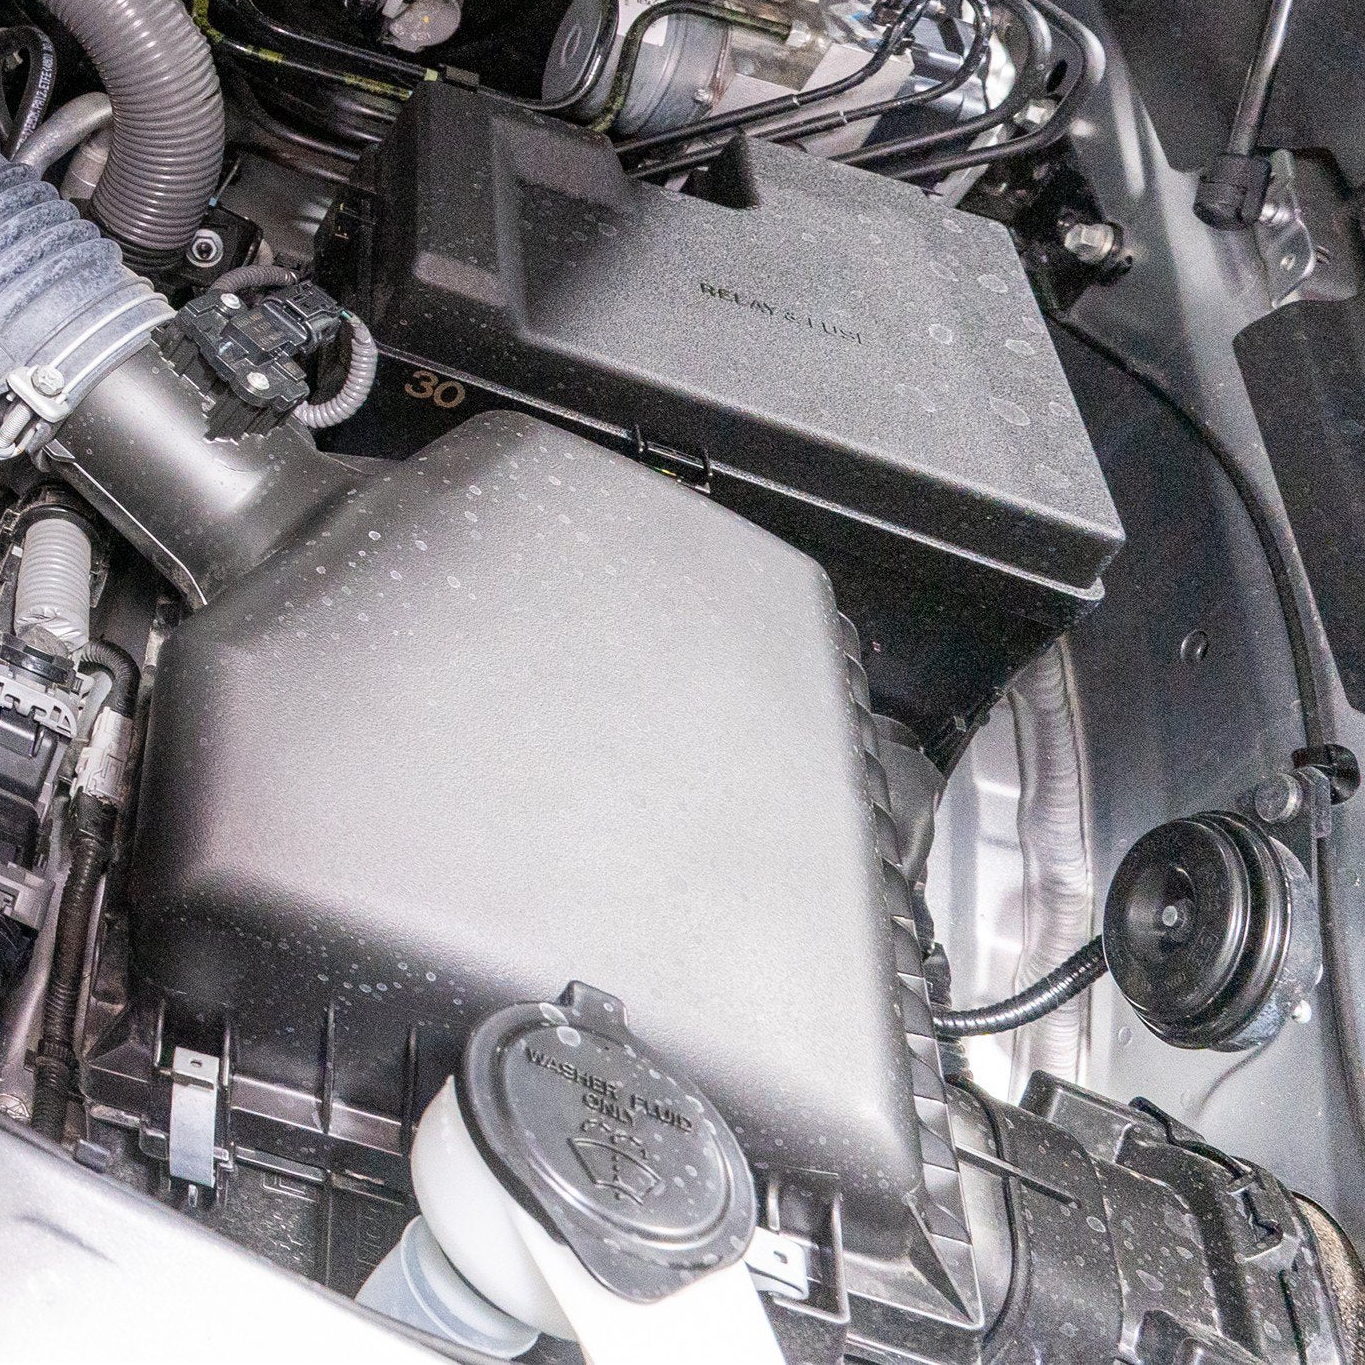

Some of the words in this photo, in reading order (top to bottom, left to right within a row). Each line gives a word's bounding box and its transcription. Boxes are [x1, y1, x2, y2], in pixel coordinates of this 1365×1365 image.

[404, 370, 466, 408] 30
[524, 1046, 618, 1101] WASHER
[630, 1093, 694, 1134] FLUID
[582, 1092, 636, 1127] ONLY
